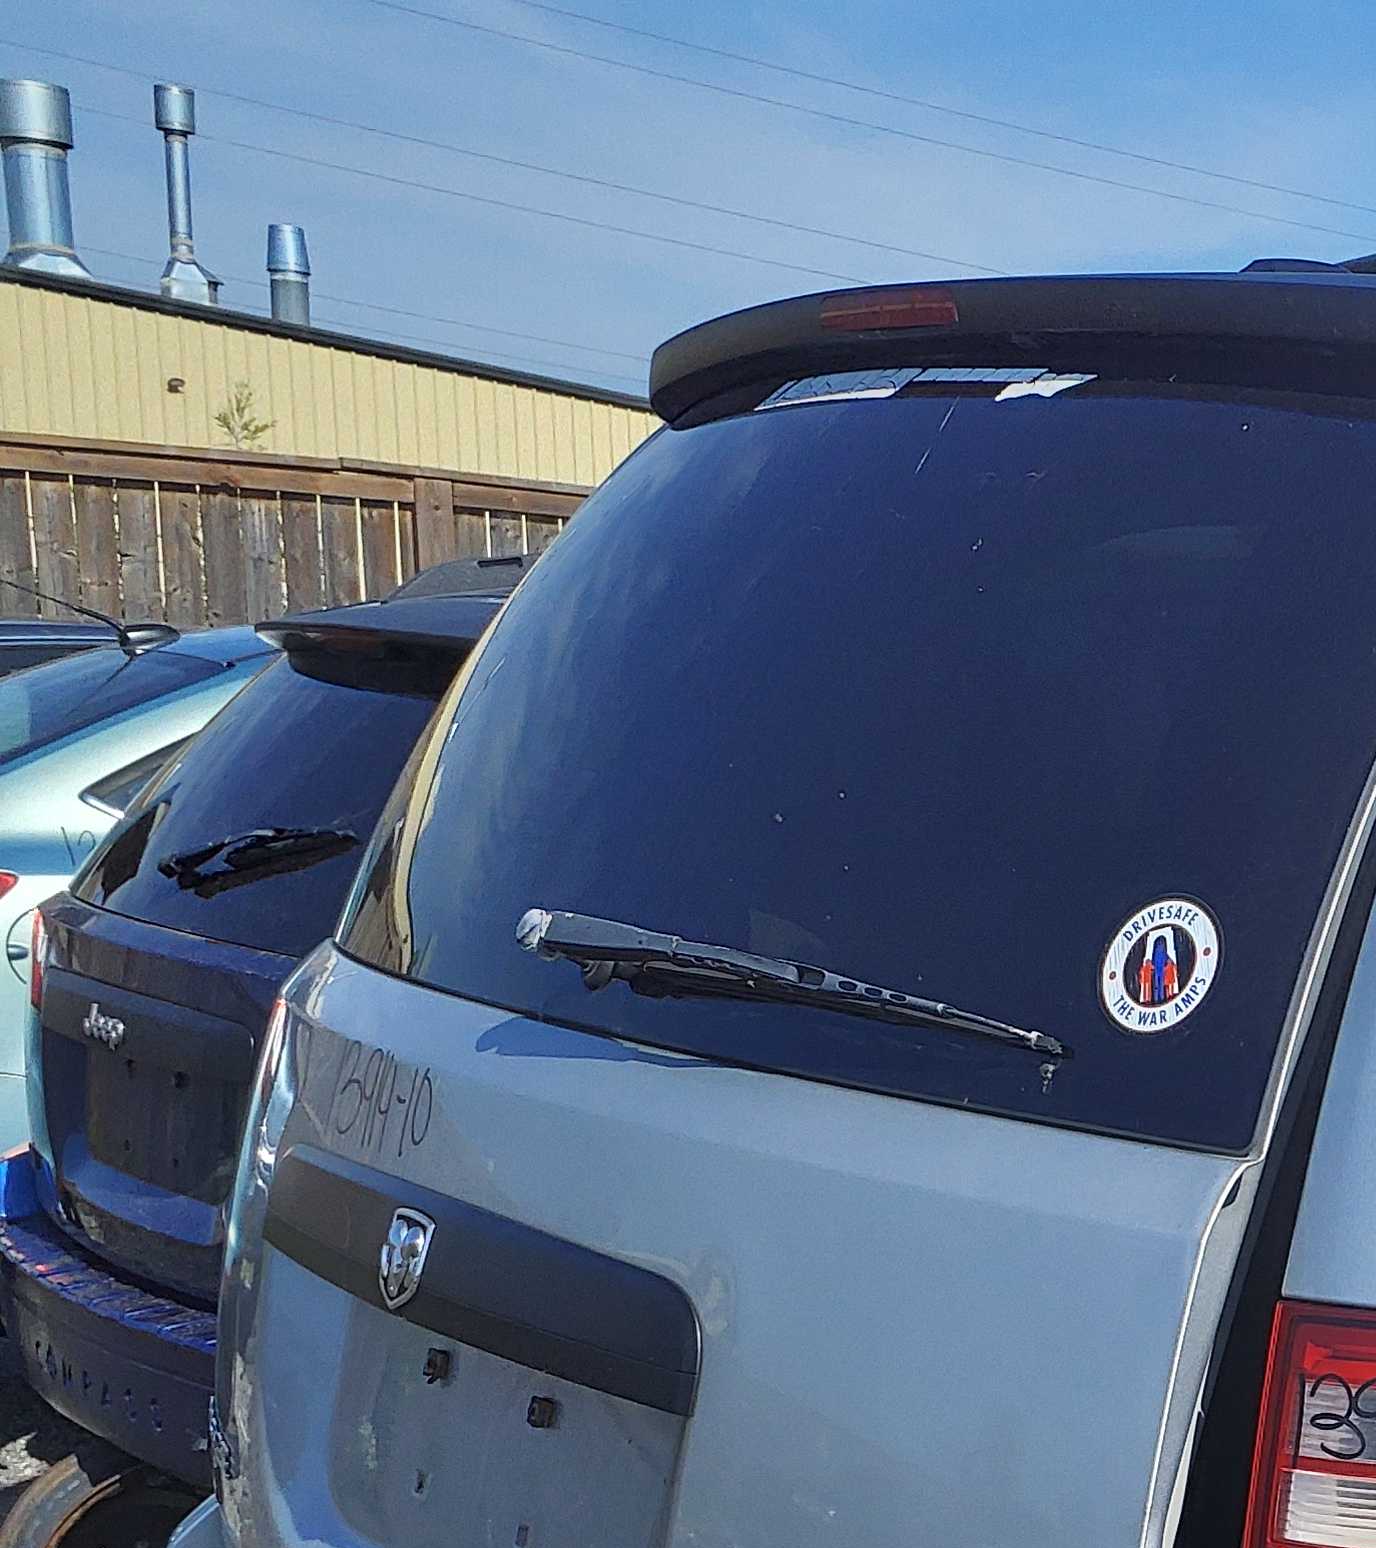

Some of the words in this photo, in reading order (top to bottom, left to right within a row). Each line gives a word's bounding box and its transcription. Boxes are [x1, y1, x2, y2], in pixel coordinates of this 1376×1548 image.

[1123, 904, 1200, 943] DRIVESAFE
[1112, 994, 1134, 1021] THE
[1137, 1009, 1168, 1027] WAR
[1174, 975, 1207, 1017] AMPS
